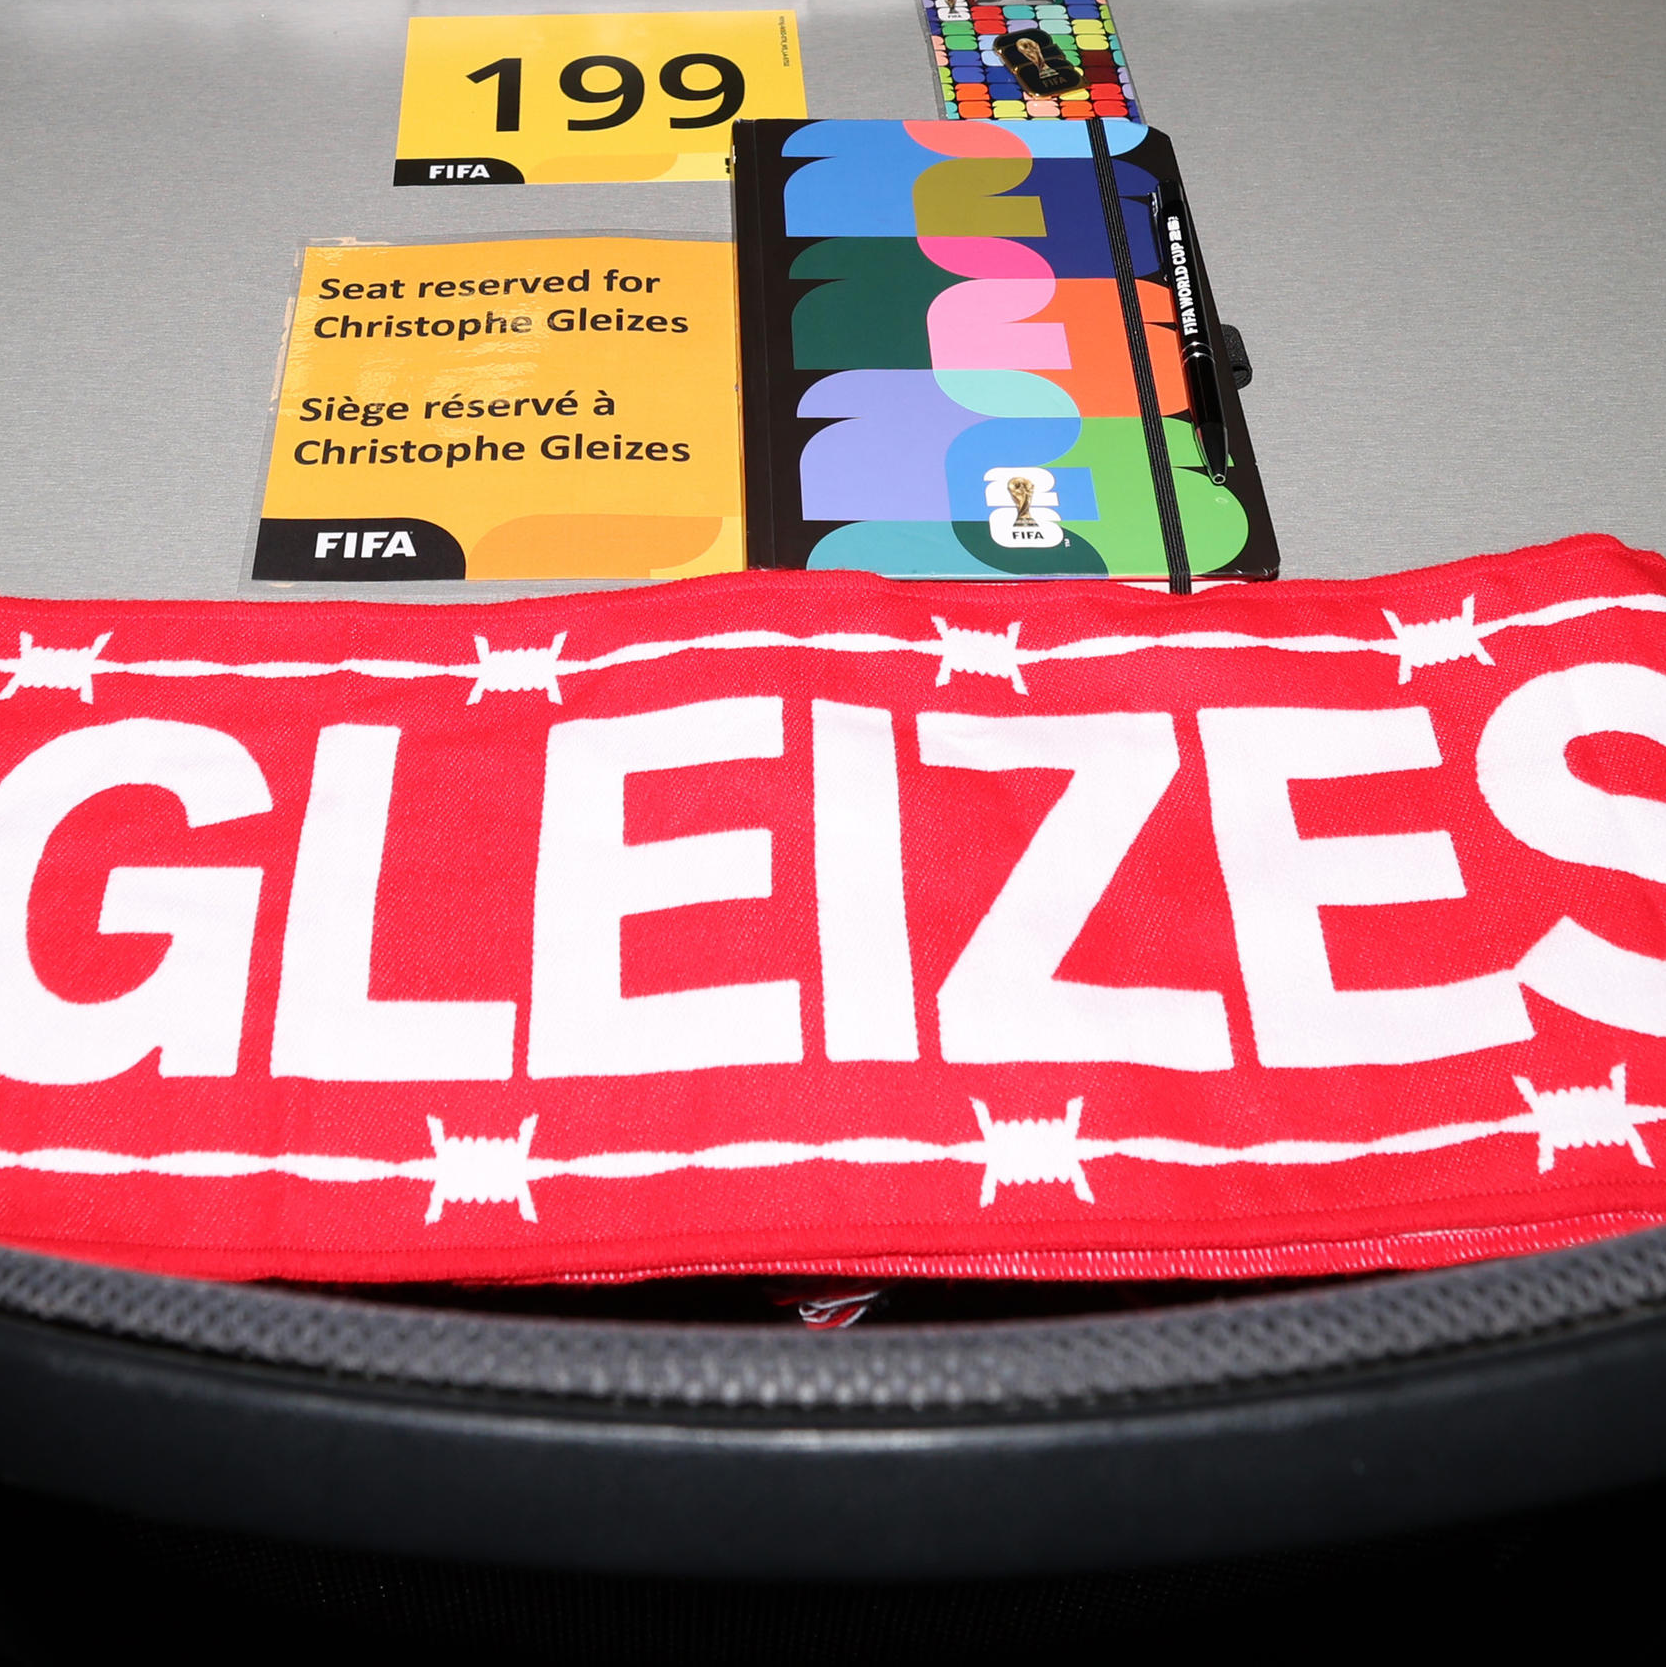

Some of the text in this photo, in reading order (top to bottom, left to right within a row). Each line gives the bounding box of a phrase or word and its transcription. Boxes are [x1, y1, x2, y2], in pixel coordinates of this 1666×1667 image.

[466, 53, 746, 132] 199
[429, 164, 491, 179] FIFA
[1170, 242, 1186, 265] CUP
[319, 269, 661, 300] Seat reserved for
[1175, 265, 1194, 310] WORLD
[313, 308, 689, 341] Christophe Gleizes
[1181, 307, 1198, 336] FIFA
[299, 389, 616, 427] Siège réservé à
[294, 433, 691, 468] Christophe Gleizes
[314, 530, 417, 560] FIFA
[1012, 531, 1045, 540] FIFA
